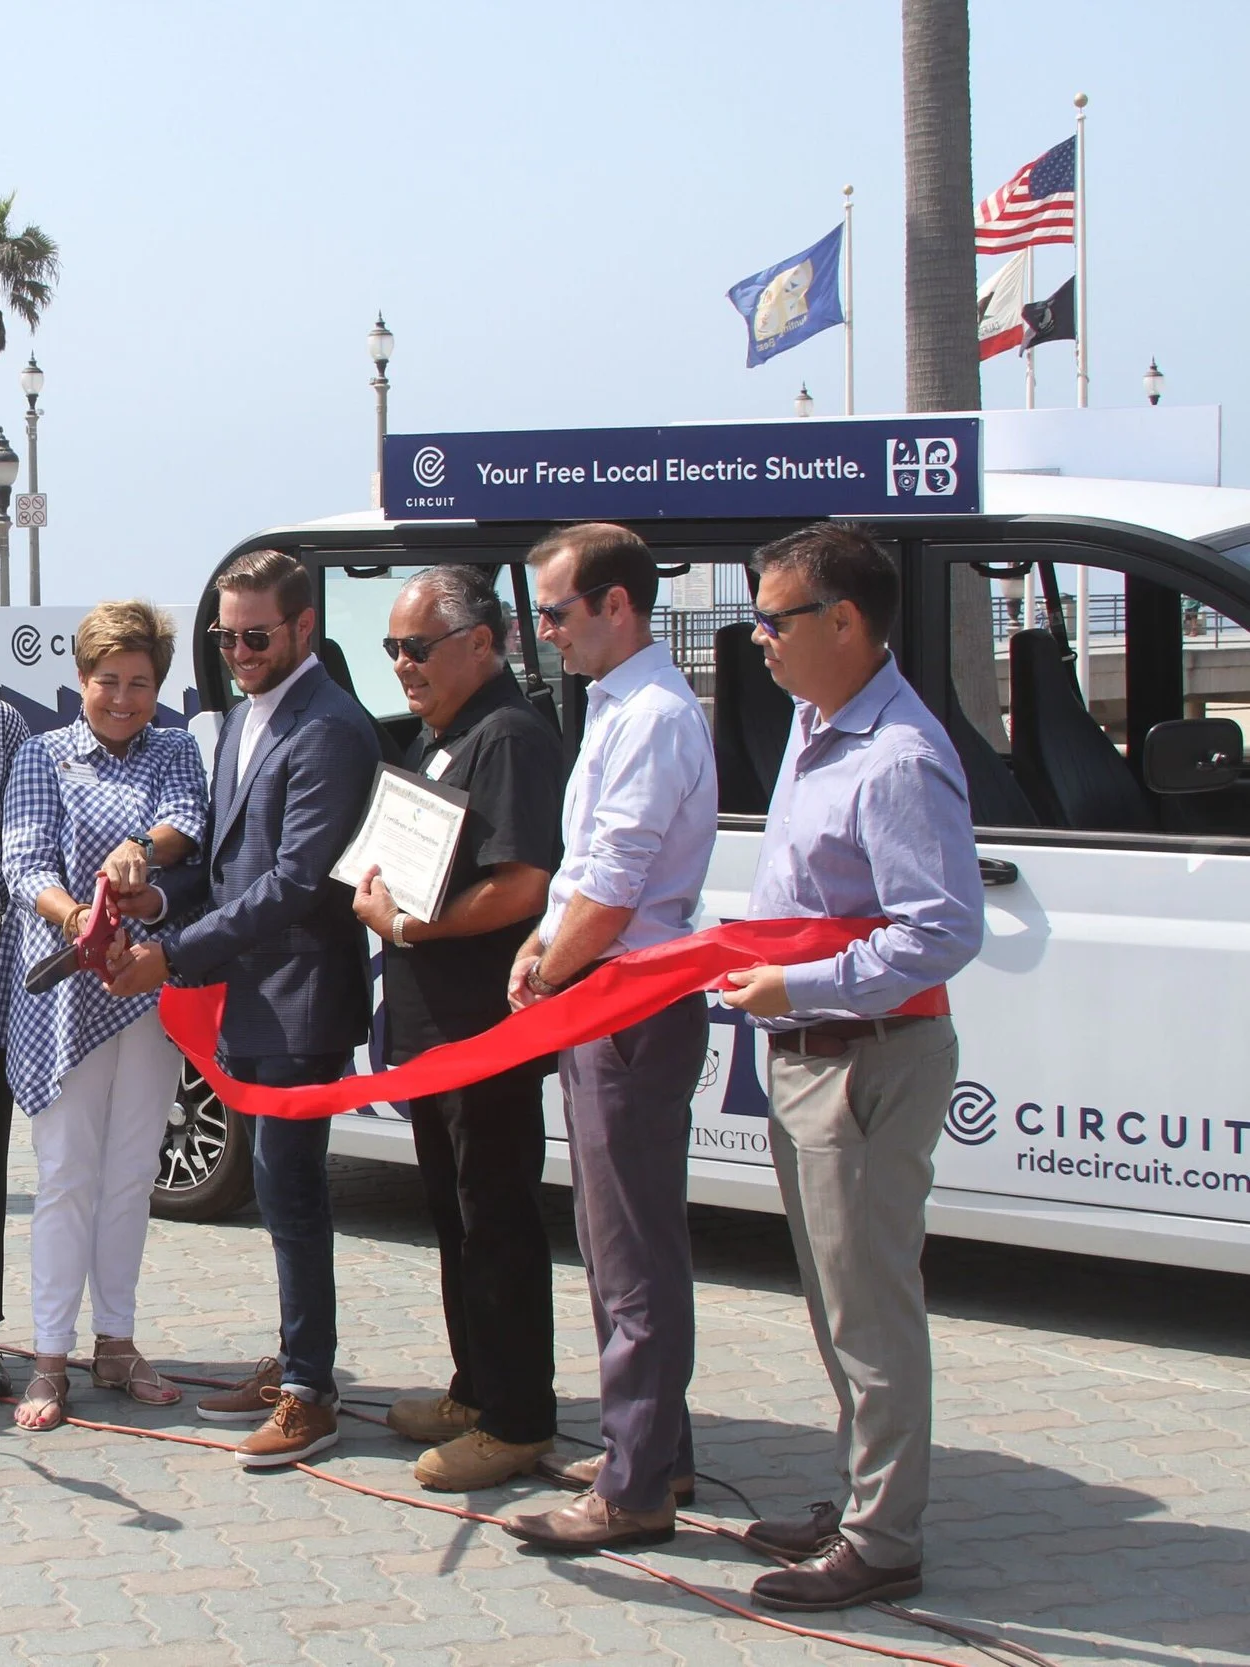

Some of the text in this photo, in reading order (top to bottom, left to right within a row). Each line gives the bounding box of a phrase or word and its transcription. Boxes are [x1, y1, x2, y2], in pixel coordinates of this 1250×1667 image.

[477, 455, 866, 485] Your Free Local Electric Shuttle.
[405, 497, 455, 507] CIRCUIT
[50, 634, 76, 656] CI
[690, 1126, 771, 1153] INGTO
[1015, 1102, 1250, 1155] CIRCUIT
[1017, 1146, 1250, 1193] ridecircuit.com
